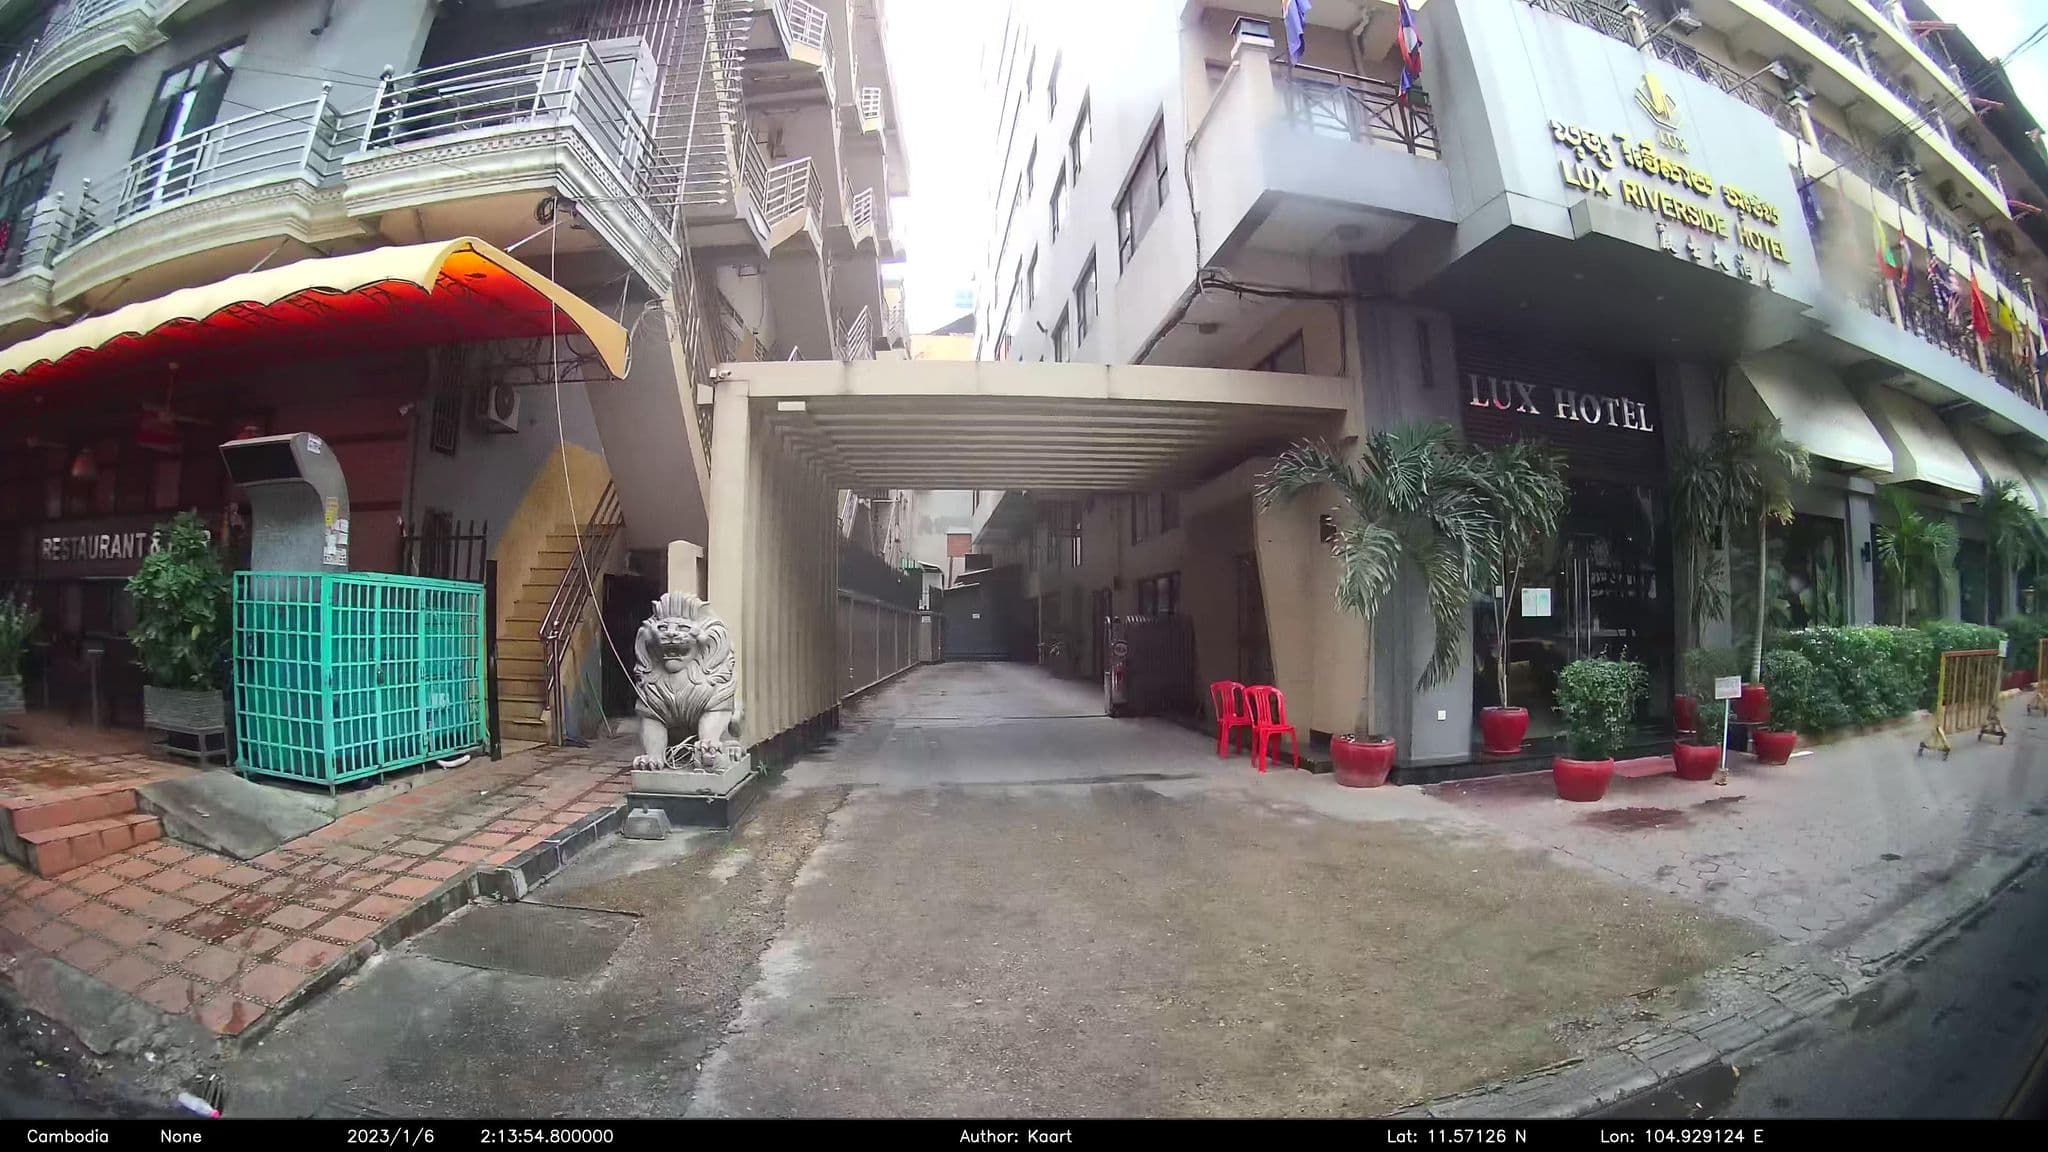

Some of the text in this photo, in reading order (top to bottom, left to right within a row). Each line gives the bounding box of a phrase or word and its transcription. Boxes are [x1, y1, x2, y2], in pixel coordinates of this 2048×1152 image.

[1656, 129, 1689, 154] LUX
[1559, 159, 1791, 265] LUX RIVERSIDE HOTEL
[1469, 374, 1655, 433] LUX HOTEL
[41, 532, 147, 561] RESTAURANT
[149, 530, 163, 555] &
